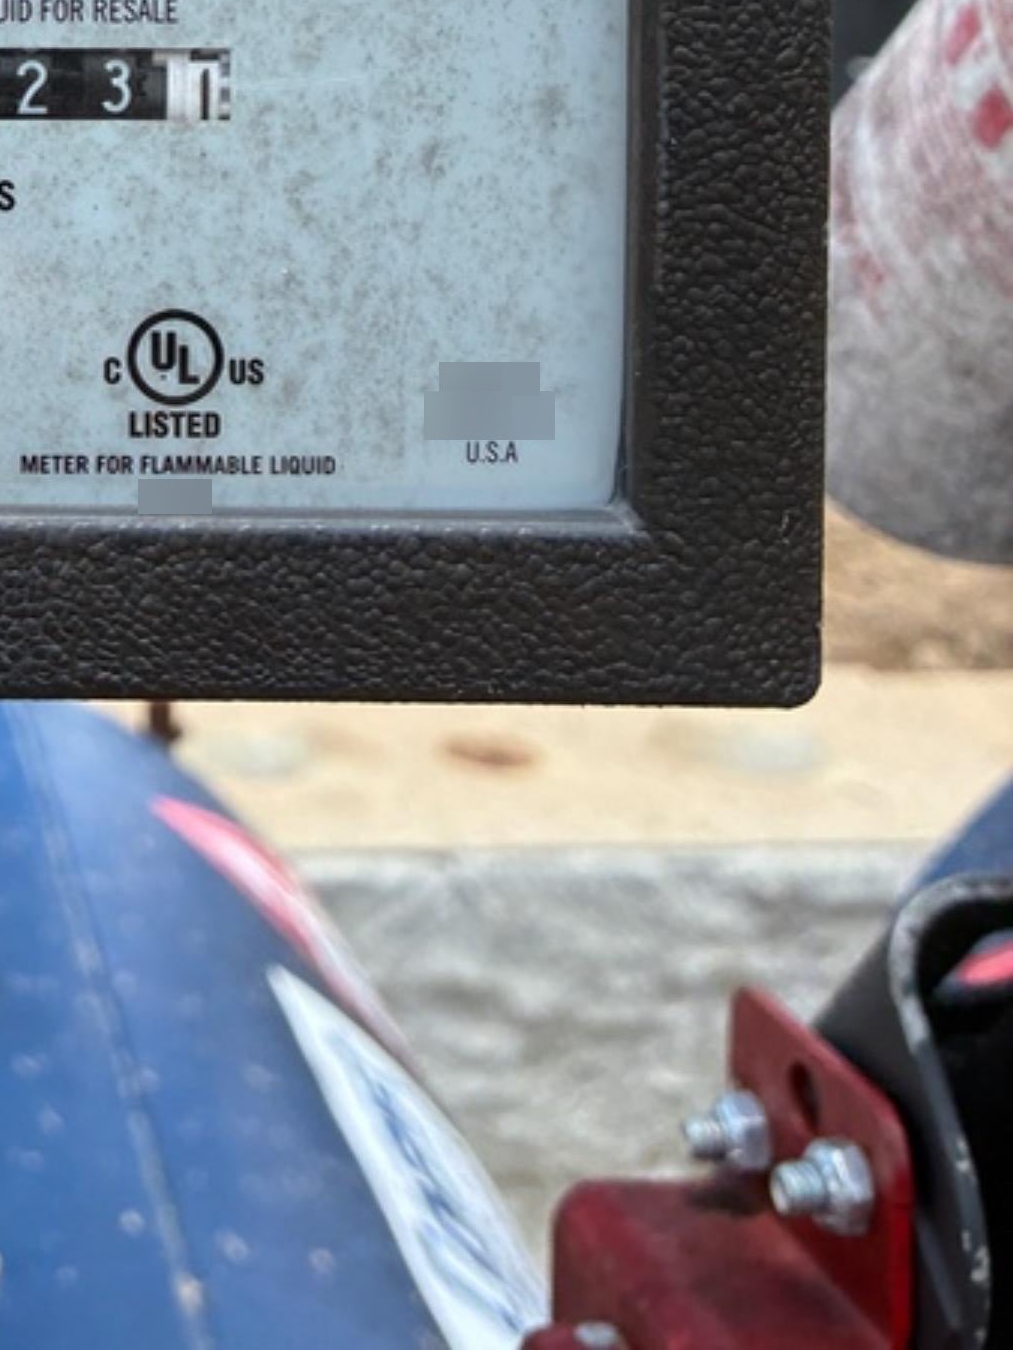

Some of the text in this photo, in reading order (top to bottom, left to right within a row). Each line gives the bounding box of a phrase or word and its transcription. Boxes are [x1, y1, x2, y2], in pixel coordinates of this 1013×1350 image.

[229, 358, 265, 386] US
[128, 411, 221, 439] LISTED
[20, 454, 336, 476] METER FOR FLAMMABLE LIQUID
